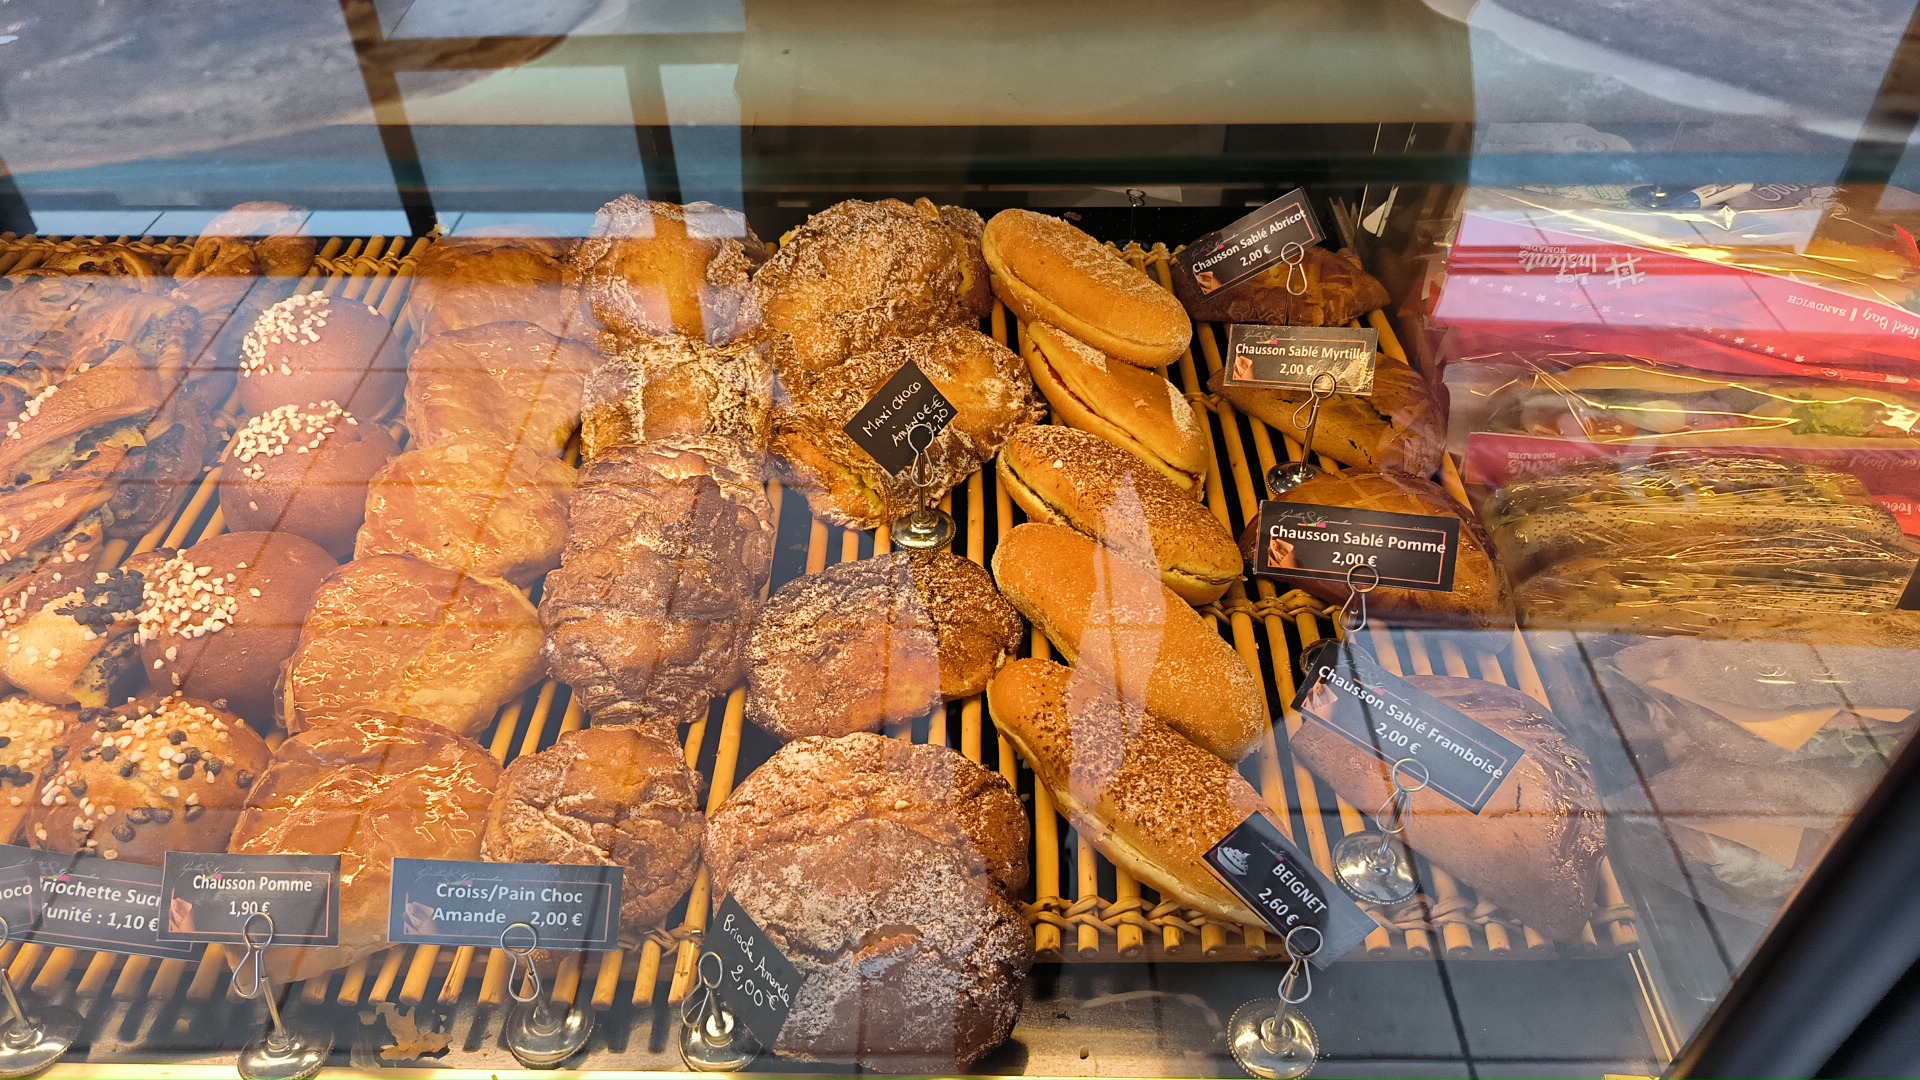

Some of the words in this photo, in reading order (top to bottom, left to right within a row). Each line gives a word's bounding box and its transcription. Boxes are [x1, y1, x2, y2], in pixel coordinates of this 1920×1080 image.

[1192, 245, 1240, 273] Chausson
[1240, 228, 1267, 250] Sablé
[1269, 210, 1307, 235] Abricot
[1240, 248, 1263, 267] 2,00
[1263, 244, 1272, 255] €
[1786, 295, 1847, 317] SANDWICH
[1863, 306, 1888, 329] Bag
[1235, 343, 1286, 356] Chausson
[1288, 344, 1318, 358] Sablé
[1321, 347, 1367, 361] Myrtille
[1279, 363, 1304, 376] 2,00
[1306, 365, 1314, 376] €
[1269, 525, 1340, 544] Chausson
[1343, 531, 1384, 548] Sablé
[1388, 536, 1447, 554] Pomme
[1332, 551, 1364, 567] 2,00
[1367, 555, 1378, 567] €
[1318, 665, 1386, 711] Chausson
[1385, 699, 1426, 734] Sablé
[1427, 727, 1504, 779] Framboise
[1375, 722, 1410, 750] 2,00
[1409, 741, 1422, 755] €
[193, 874, 255, 890] Chausson
[259, 877, 312, 892] Pomme
[436, 883, 535, 902] Croiss/Pain
[540, 888, 583, 903] Choc
[1272, 863, 1328, 914] BEIGNET
[125, 889, 162, 907] Sucr
[229, 901, 258, 918] 1,90
[1258, 887, 1289, 916] 2,60
[1286, 914, 1299, 926] €
[42, 902, 92, 923] 'unité
[107, 912, 145, 930] 1,10
[432, 907, 506, 924] Amande
[530, 911, 568, 927] 2,00
[571, 912, 583, 927] €
[723, 914, 754, 963] Brioche
[754, 956, 790, 1008] Amande
